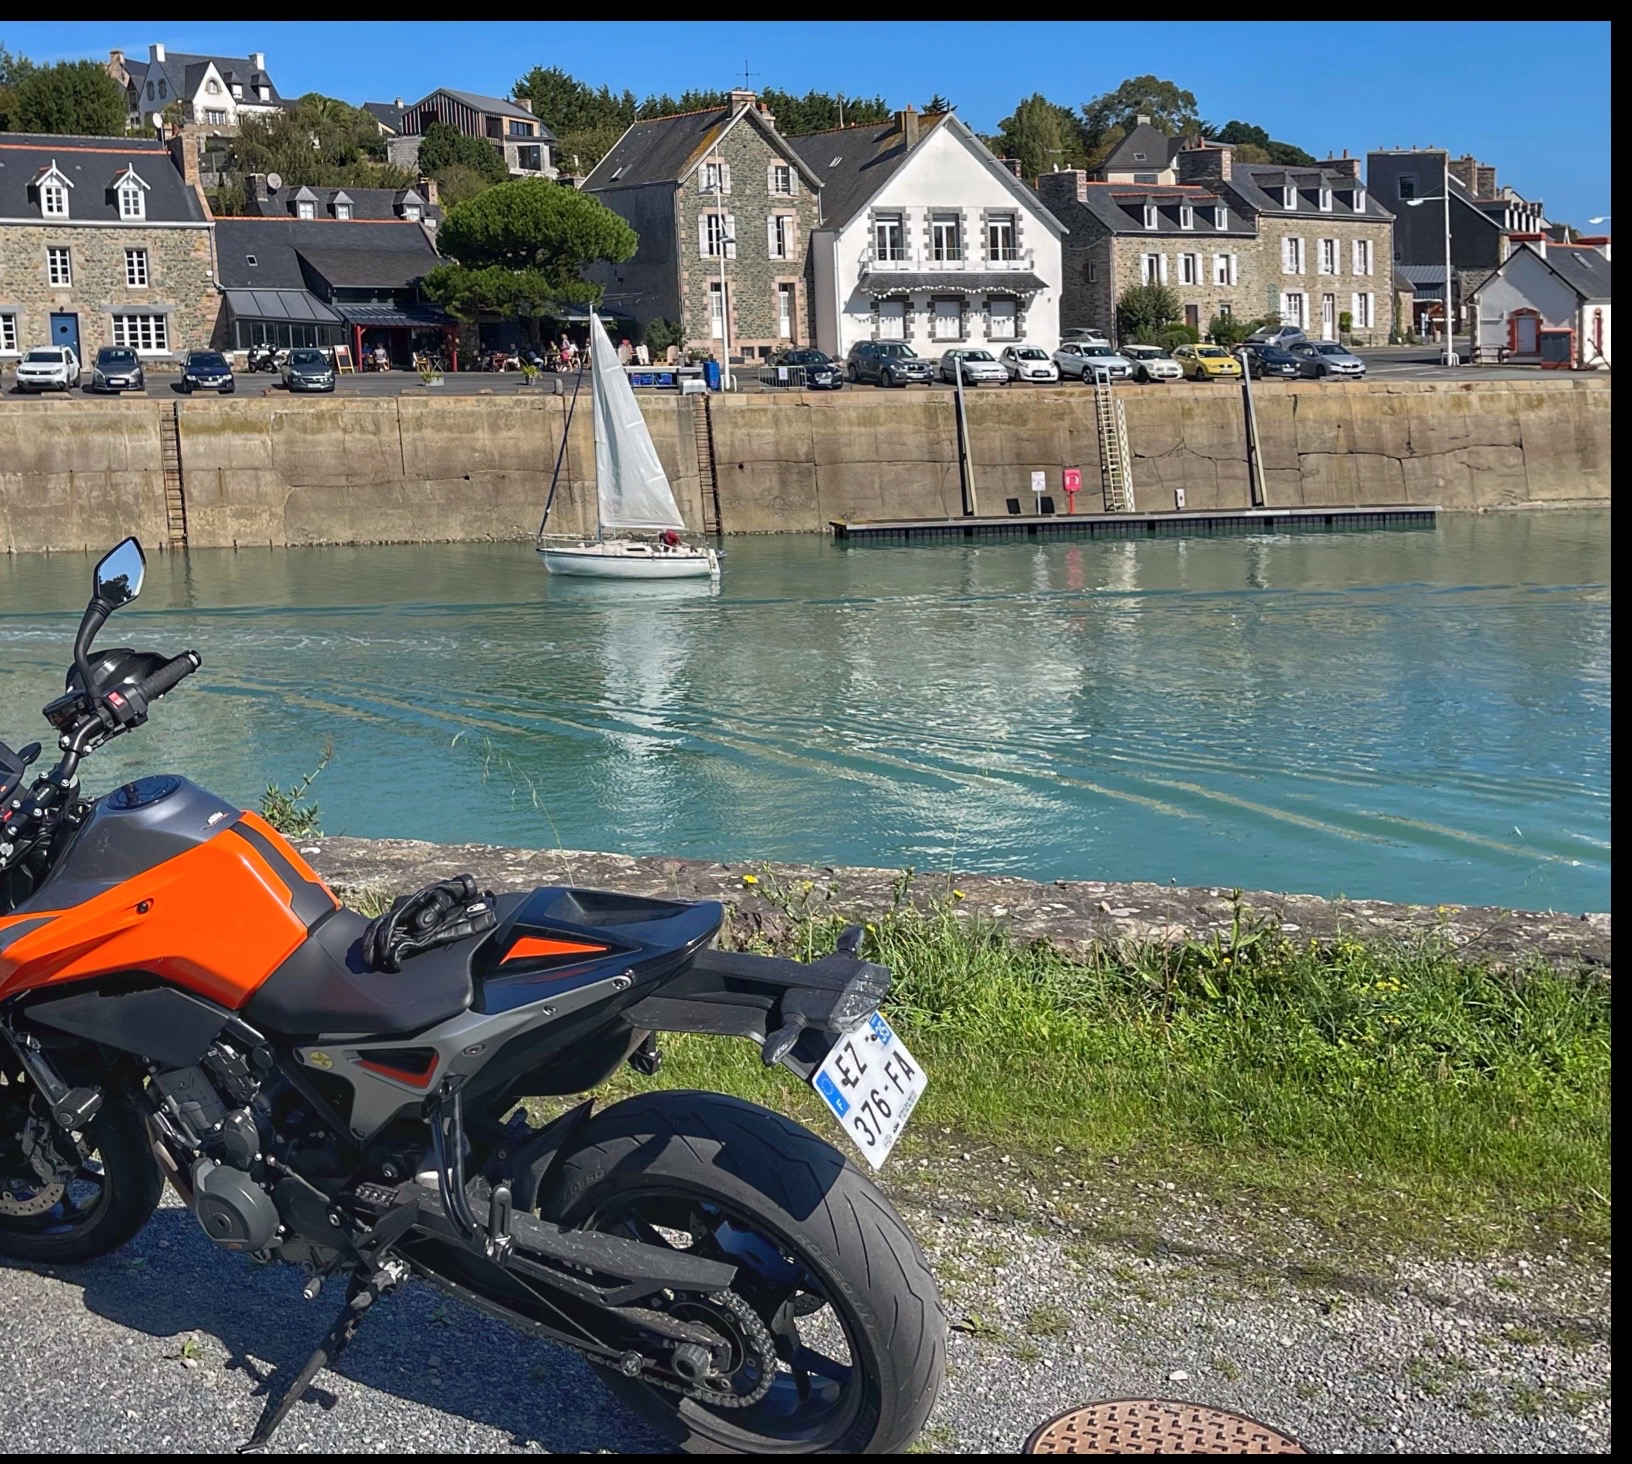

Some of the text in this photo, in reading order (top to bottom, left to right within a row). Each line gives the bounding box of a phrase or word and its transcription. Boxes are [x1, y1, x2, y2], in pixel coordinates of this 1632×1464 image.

[874, 1019, 891, 1043] 35
[836, 1097, 845, 1112] F
[854, 1050, 916, 1147] 376-FA
